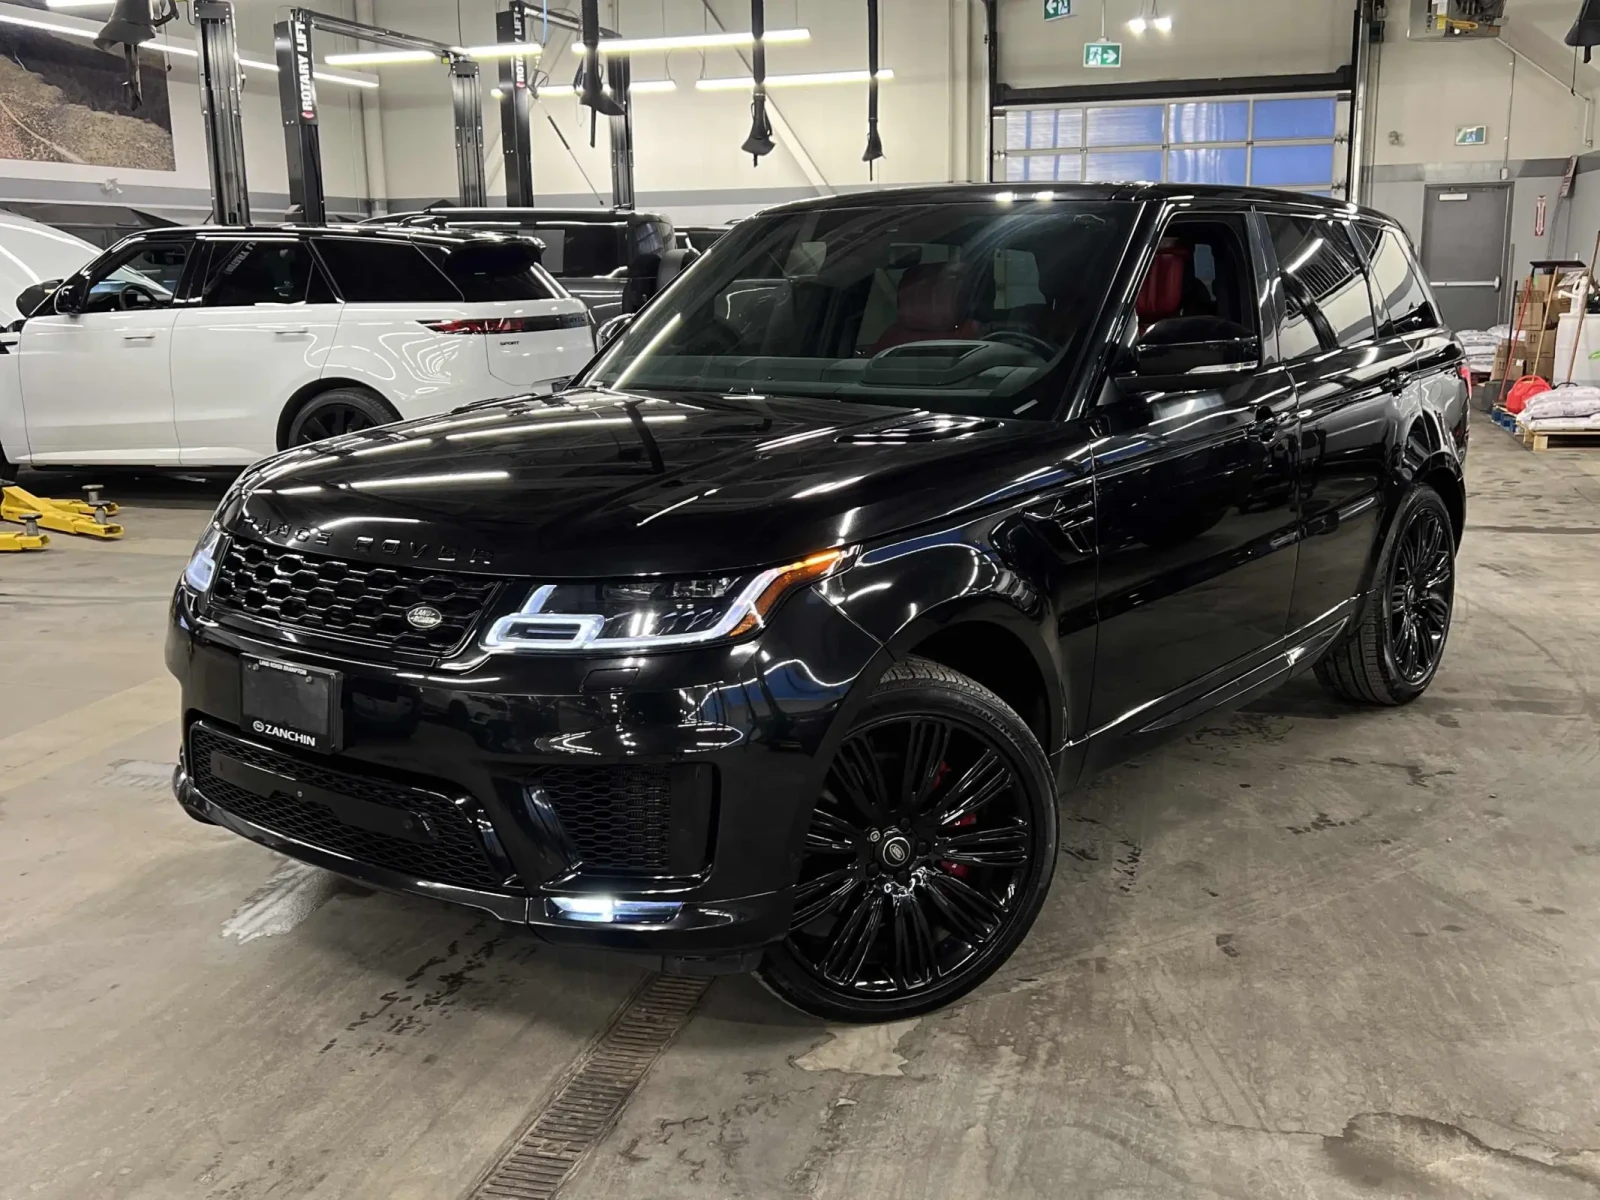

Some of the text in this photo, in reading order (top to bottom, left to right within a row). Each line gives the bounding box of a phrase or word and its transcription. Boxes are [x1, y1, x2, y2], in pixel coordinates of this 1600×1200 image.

[514, 12, 522, 35] LIFT
[295, 21, 313, 110] ROTARY LIFT
[242, 518, 494, 565] RANGE ROVER
[265, 724, 316, 747] ZANCHIN
